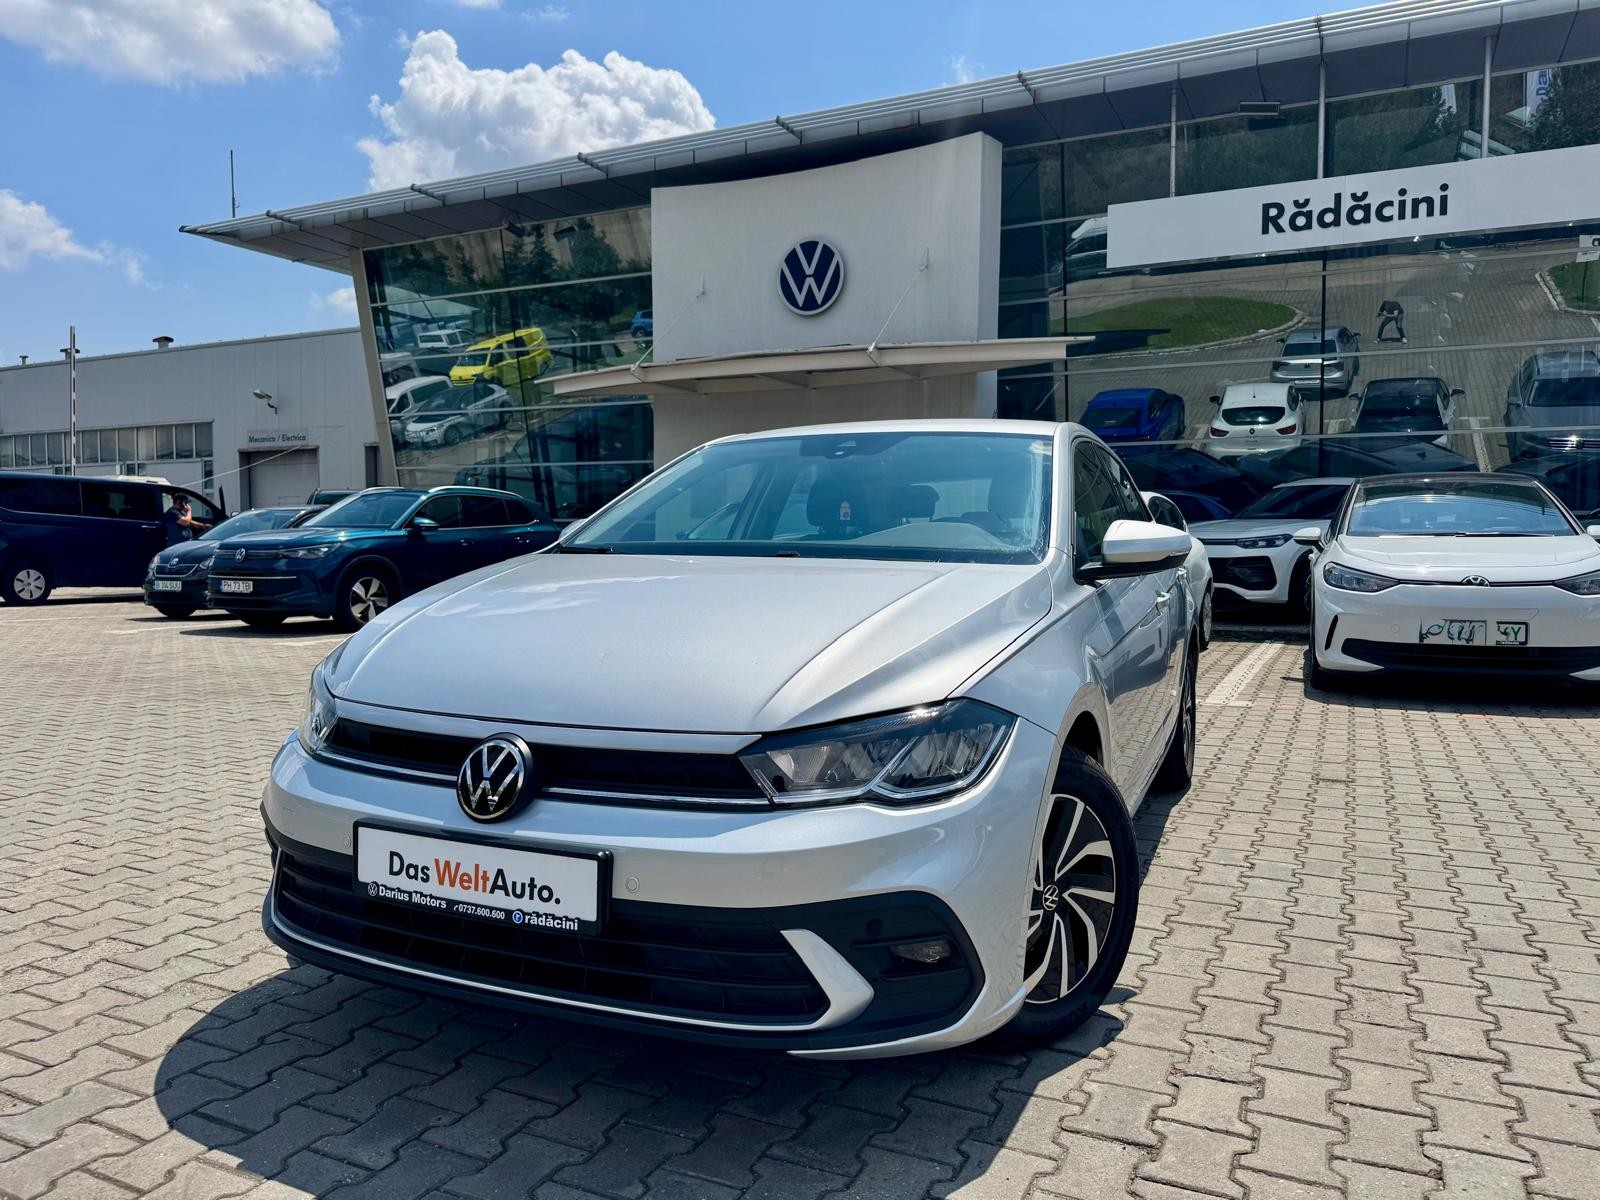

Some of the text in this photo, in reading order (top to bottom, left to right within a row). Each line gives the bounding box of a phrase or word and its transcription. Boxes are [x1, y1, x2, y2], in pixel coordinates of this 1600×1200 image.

[1261, 183, 1449, 235] Rădăcini
[224, 581, 231, 590] PH
[233, 581, 240, 590] 73
[389, 850, 561, 904] Das WeltAuto.
[379, 886, 409, 901] Darius
[411, 893, 447, 909] Motors
[458, 903, 505, 920] 0737.600.600
[524, 911, 578, 931] rădăcini
